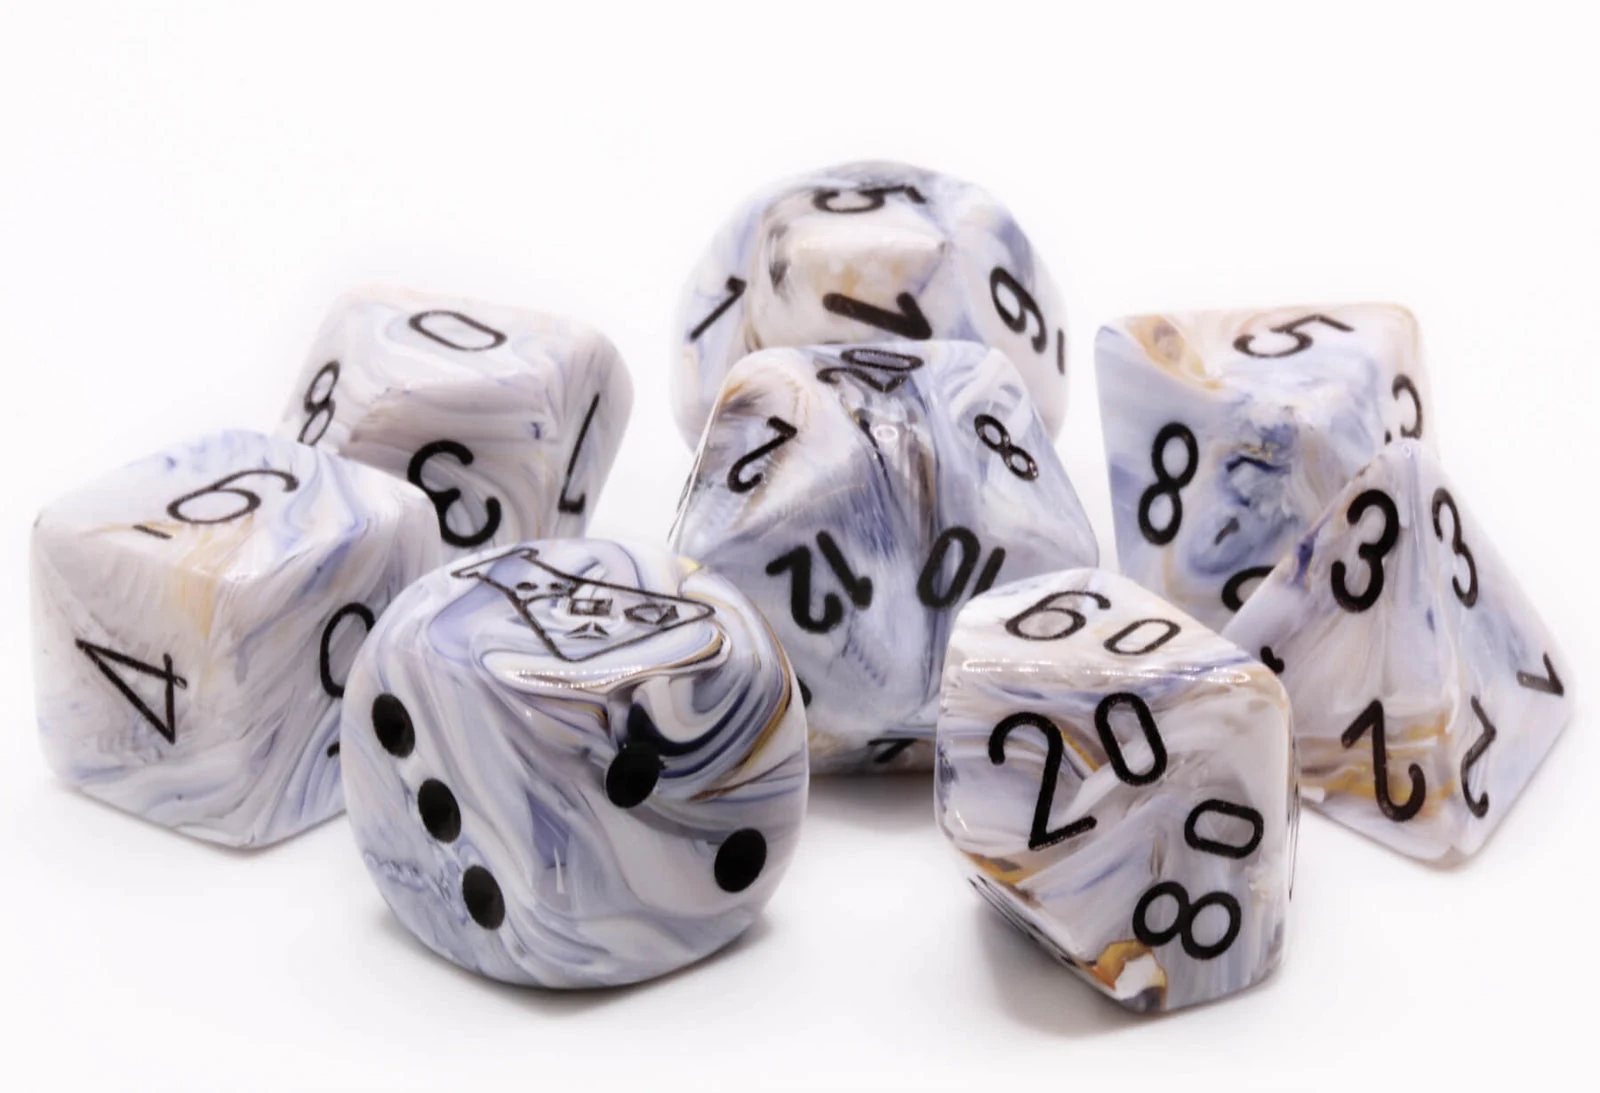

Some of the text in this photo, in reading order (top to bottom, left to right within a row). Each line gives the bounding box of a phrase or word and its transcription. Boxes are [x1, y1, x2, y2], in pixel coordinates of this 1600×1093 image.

[813, 184, 927, 213] 5
[408, 310, 507, 352] 0
[816, 348, 925, 394] 20
[1234, 316, 1355, 356] 5
[299, 359, 339, 446] 8
[973, 414, 1038, 481] 8
[406, 439, 502, 549] 3
[1137, 421, 1199, 546] 8
[765, 531, 873, 634] 12
[1330, 488, 1401, 613] 3
[1431, 489, 1479, 609] 3
[1005, 589, 1181, 656] 60
[75, 639, 188, 745] 4
[987, 691, 1168, 851] 20
[1341, 699, 1427, 823] 2
[1460, 697, 1497, 819] 2
[1131, 798, 1264, 961] 80
